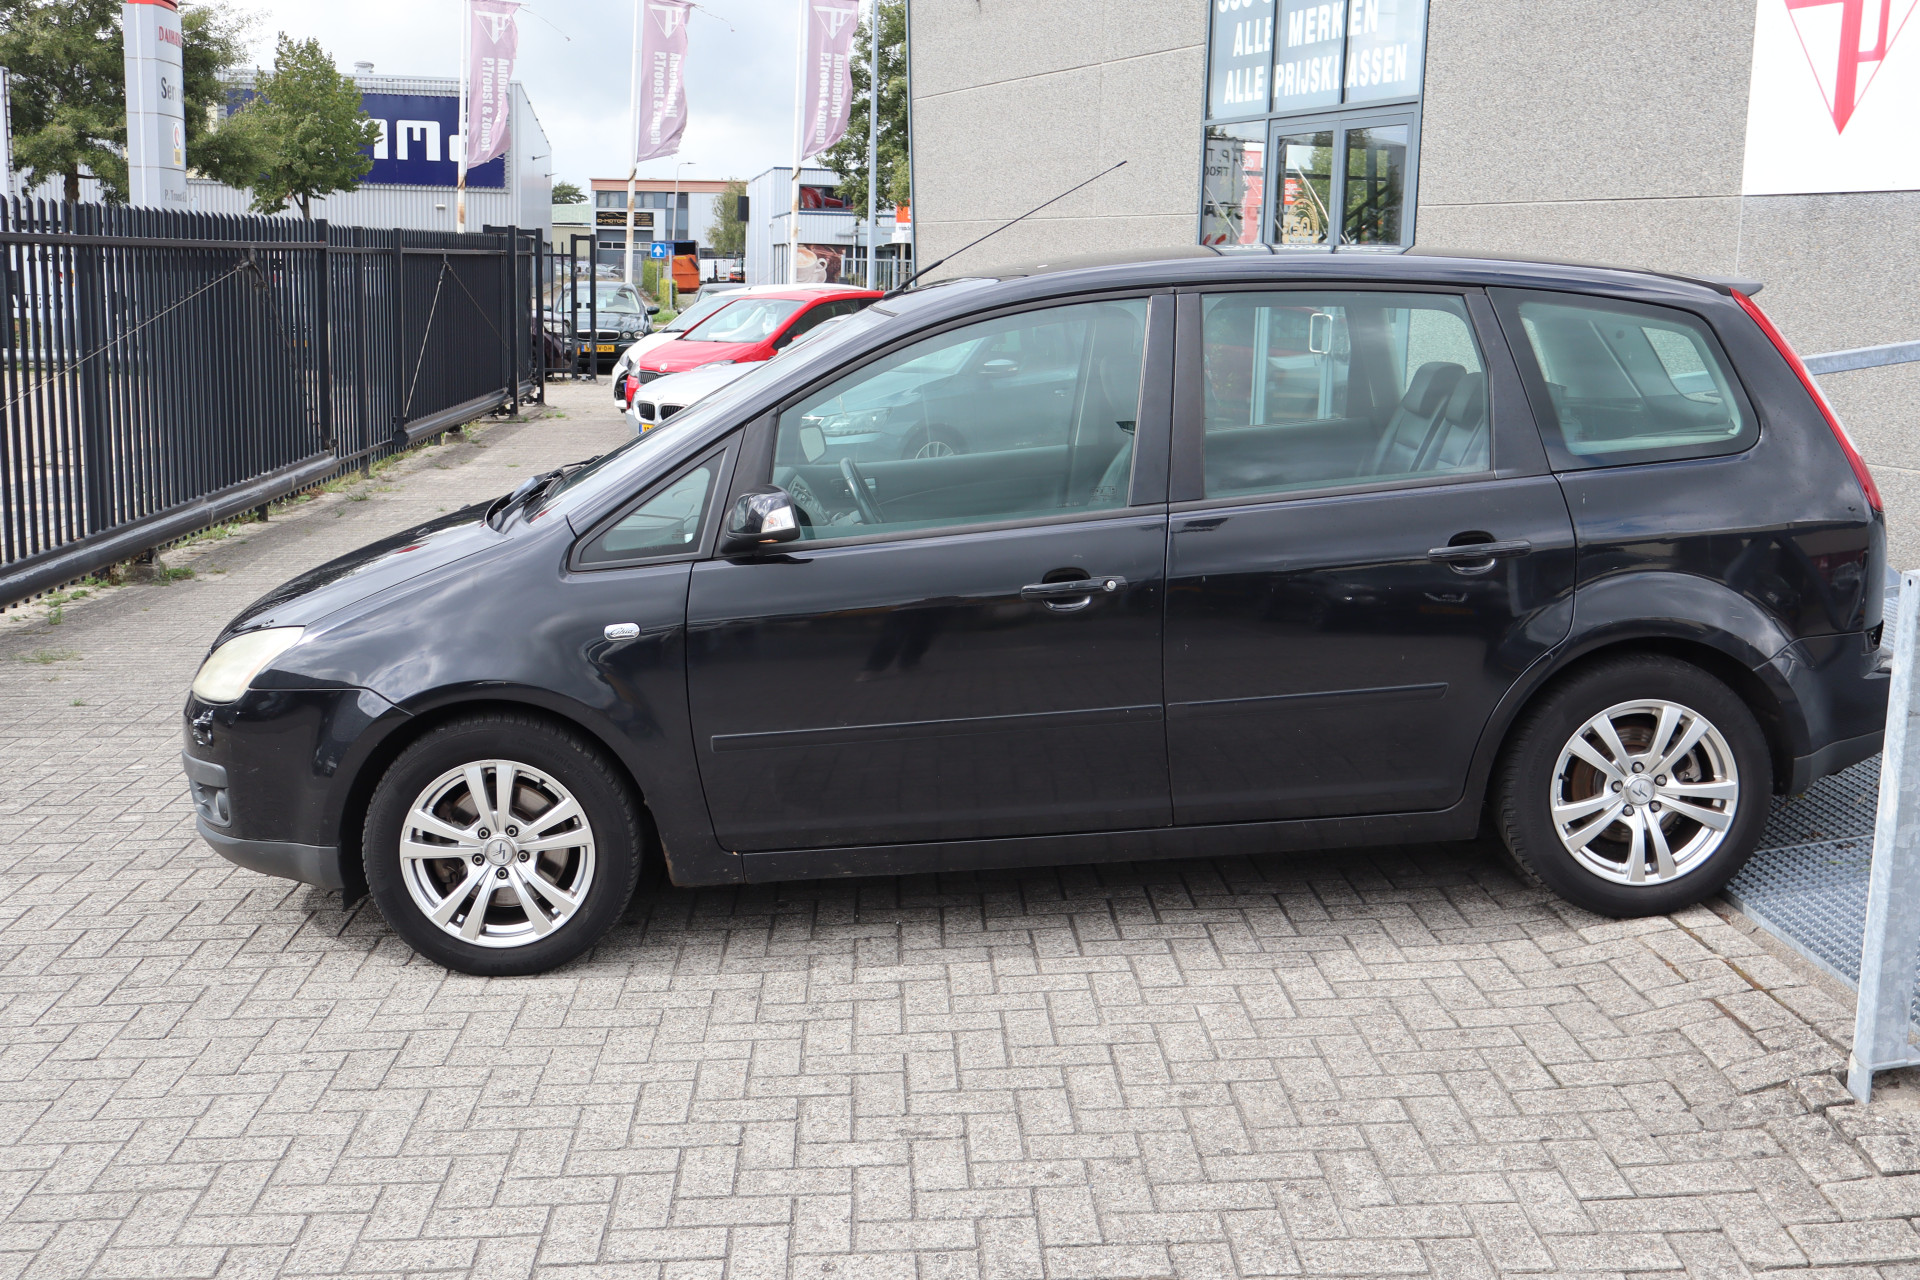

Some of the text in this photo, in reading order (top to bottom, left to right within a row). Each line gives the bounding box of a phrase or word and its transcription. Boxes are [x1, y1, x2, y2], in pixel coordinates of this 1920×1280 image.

[1232, 0, 1379, 57] ALLE MERKEN
[831, 53, 844, 118] Autobedrijf
[1223, 43, 1408, 105] ALLE PRIJSKLASSEN
[482, 106, 493, 116] &
[653, 100, 664, 109] &
[650, 111, 662, 145] zonen
[815, 110, 828, 144] zonen
